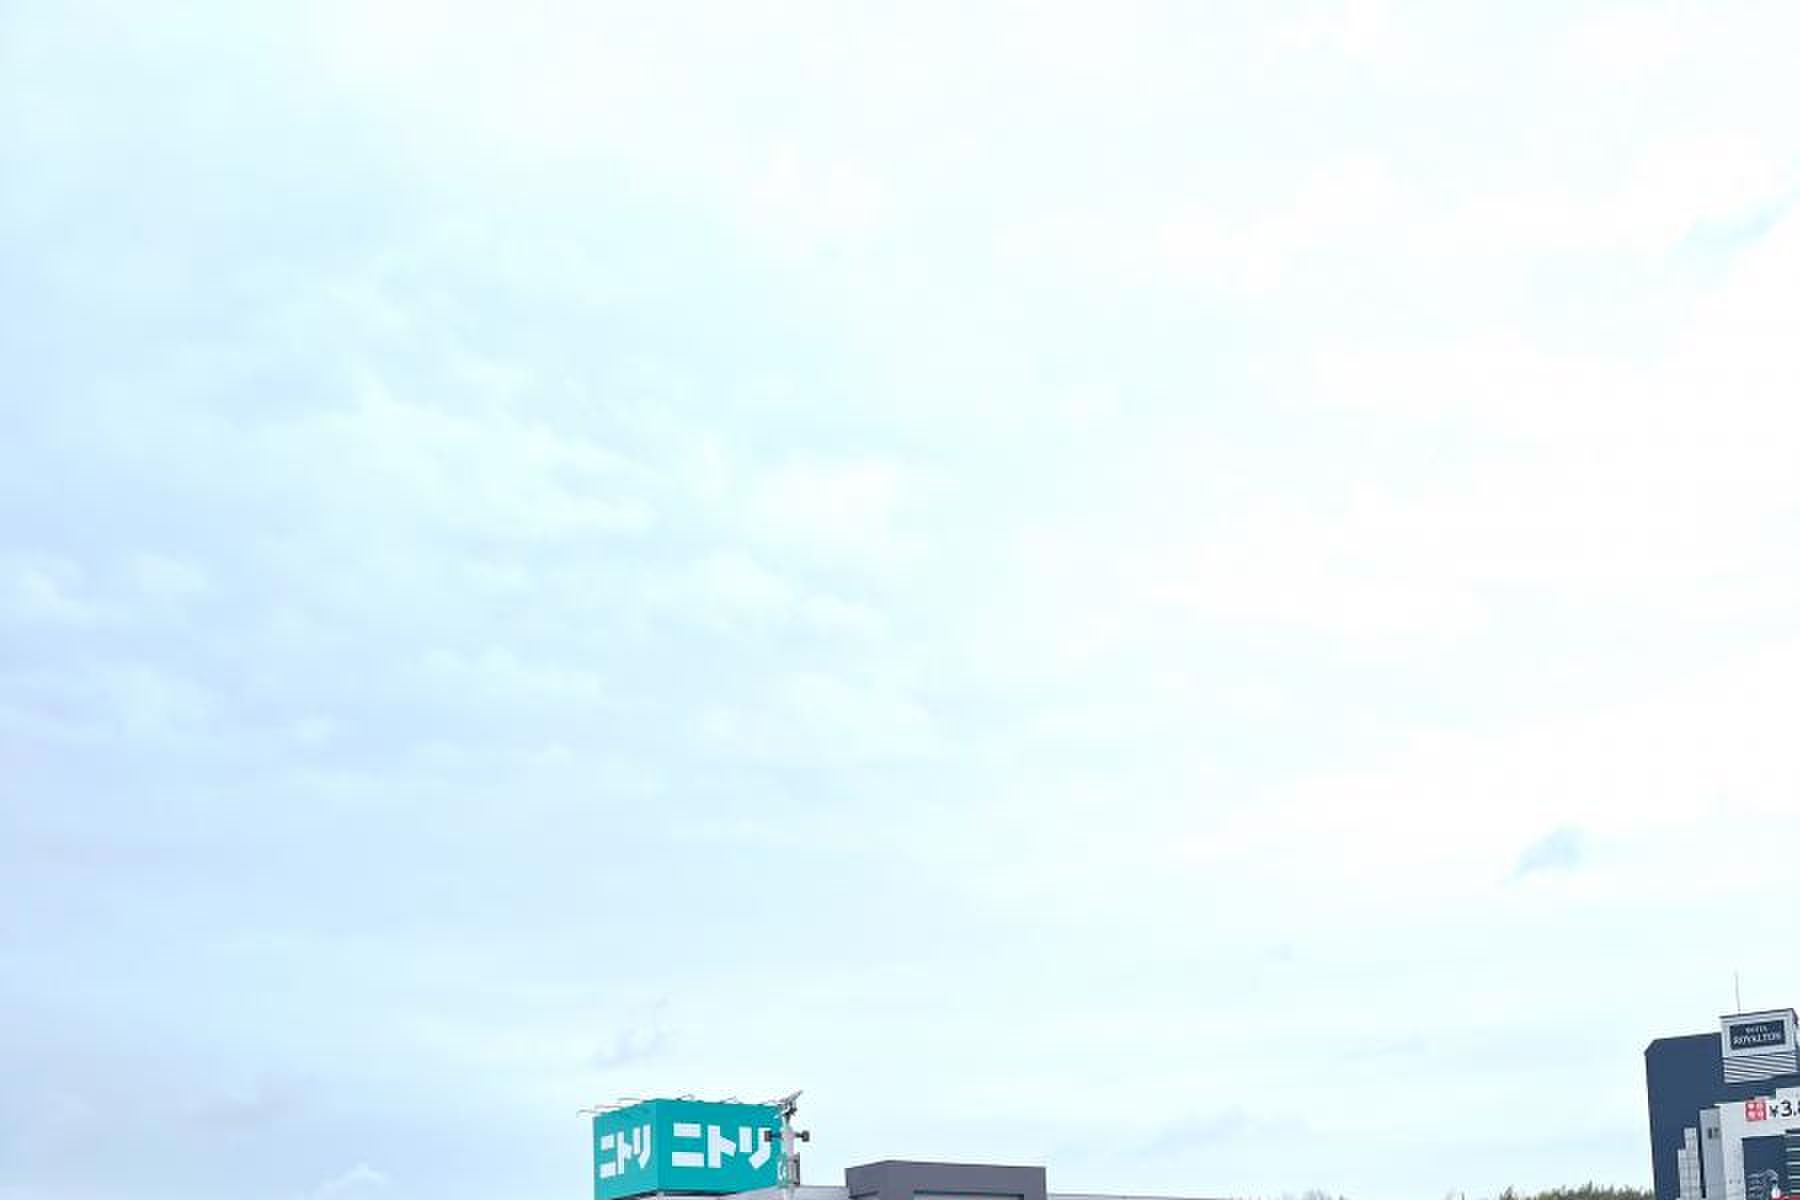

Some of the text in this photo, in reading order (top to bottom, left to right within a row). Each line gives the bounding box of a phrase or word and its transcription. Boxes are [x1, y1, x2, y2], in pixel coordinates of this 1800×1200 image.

[1769, 1099, 1800, 1118] ¥3.
[600, 1124, 651, 1179] ニトリ
[671, 1122, 771, 1169] ニトリ
